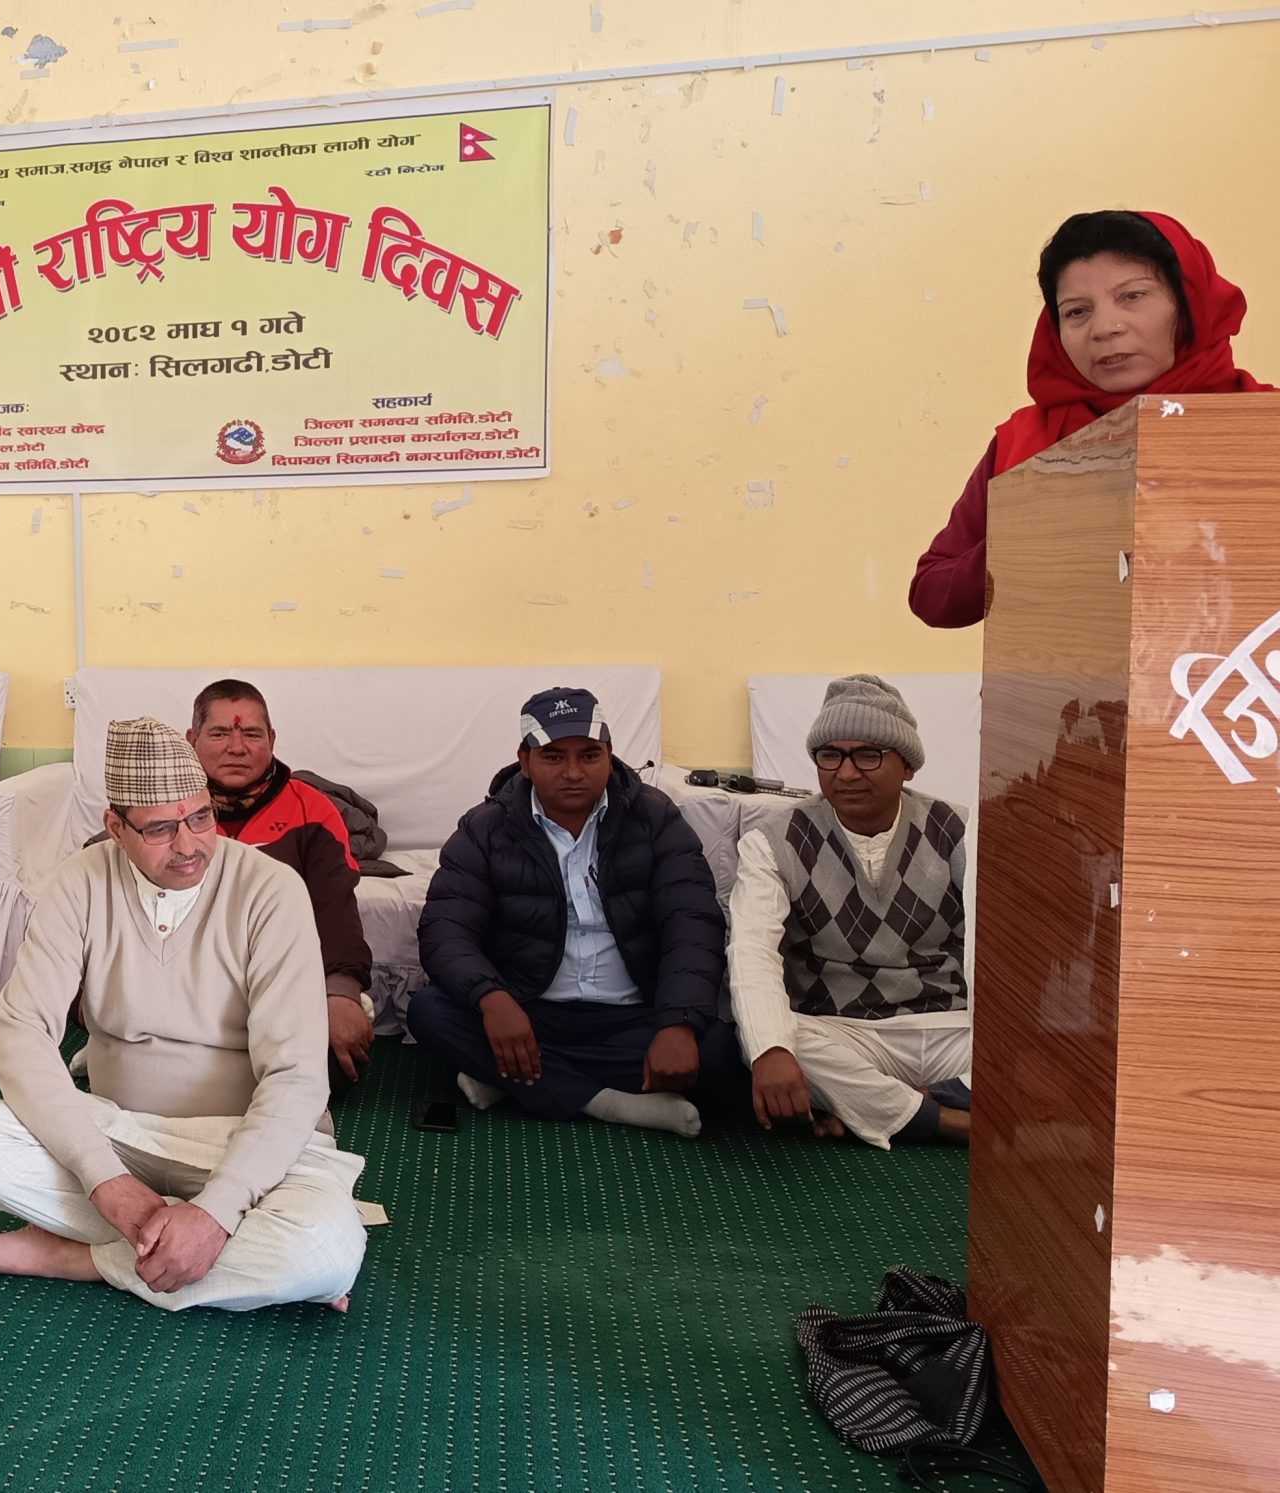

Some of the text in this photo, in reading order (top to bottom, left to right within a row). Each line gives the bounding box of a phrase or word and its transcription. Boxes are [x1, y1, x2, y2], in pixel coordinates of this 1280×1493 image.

[119, 153, 170, 169] नेपाल
[175, 154, 189, 166] र
[194, 149, 233, 164] विश्व
[239, 142, 317, 161] शान्तीका
[323, 136, 370, 154] लागी
[397, 164, 445, 175] निरोग
[33, 198, 216, 291] राष्ट्रिय
[231, 185, 351, 272] योग
[361, 206, 523, 341] दिवस
[88, 311, 307, 344] २०८२ माघ १ गते
[372, 393, 433, 410] सहकार्य
[16, 425, 67, 437] स्वास्थ्य
[70, 423, 106, 435] केन्द्र
[304, 418, 354, 431] जिल्ला
[294, 434, 344, 448] जिल्ला
[349, 433, 406, 446] प्रशासन
[271, 454, 332, 467] दिपायल
[336, 451, 401, 465] सिलगढी
